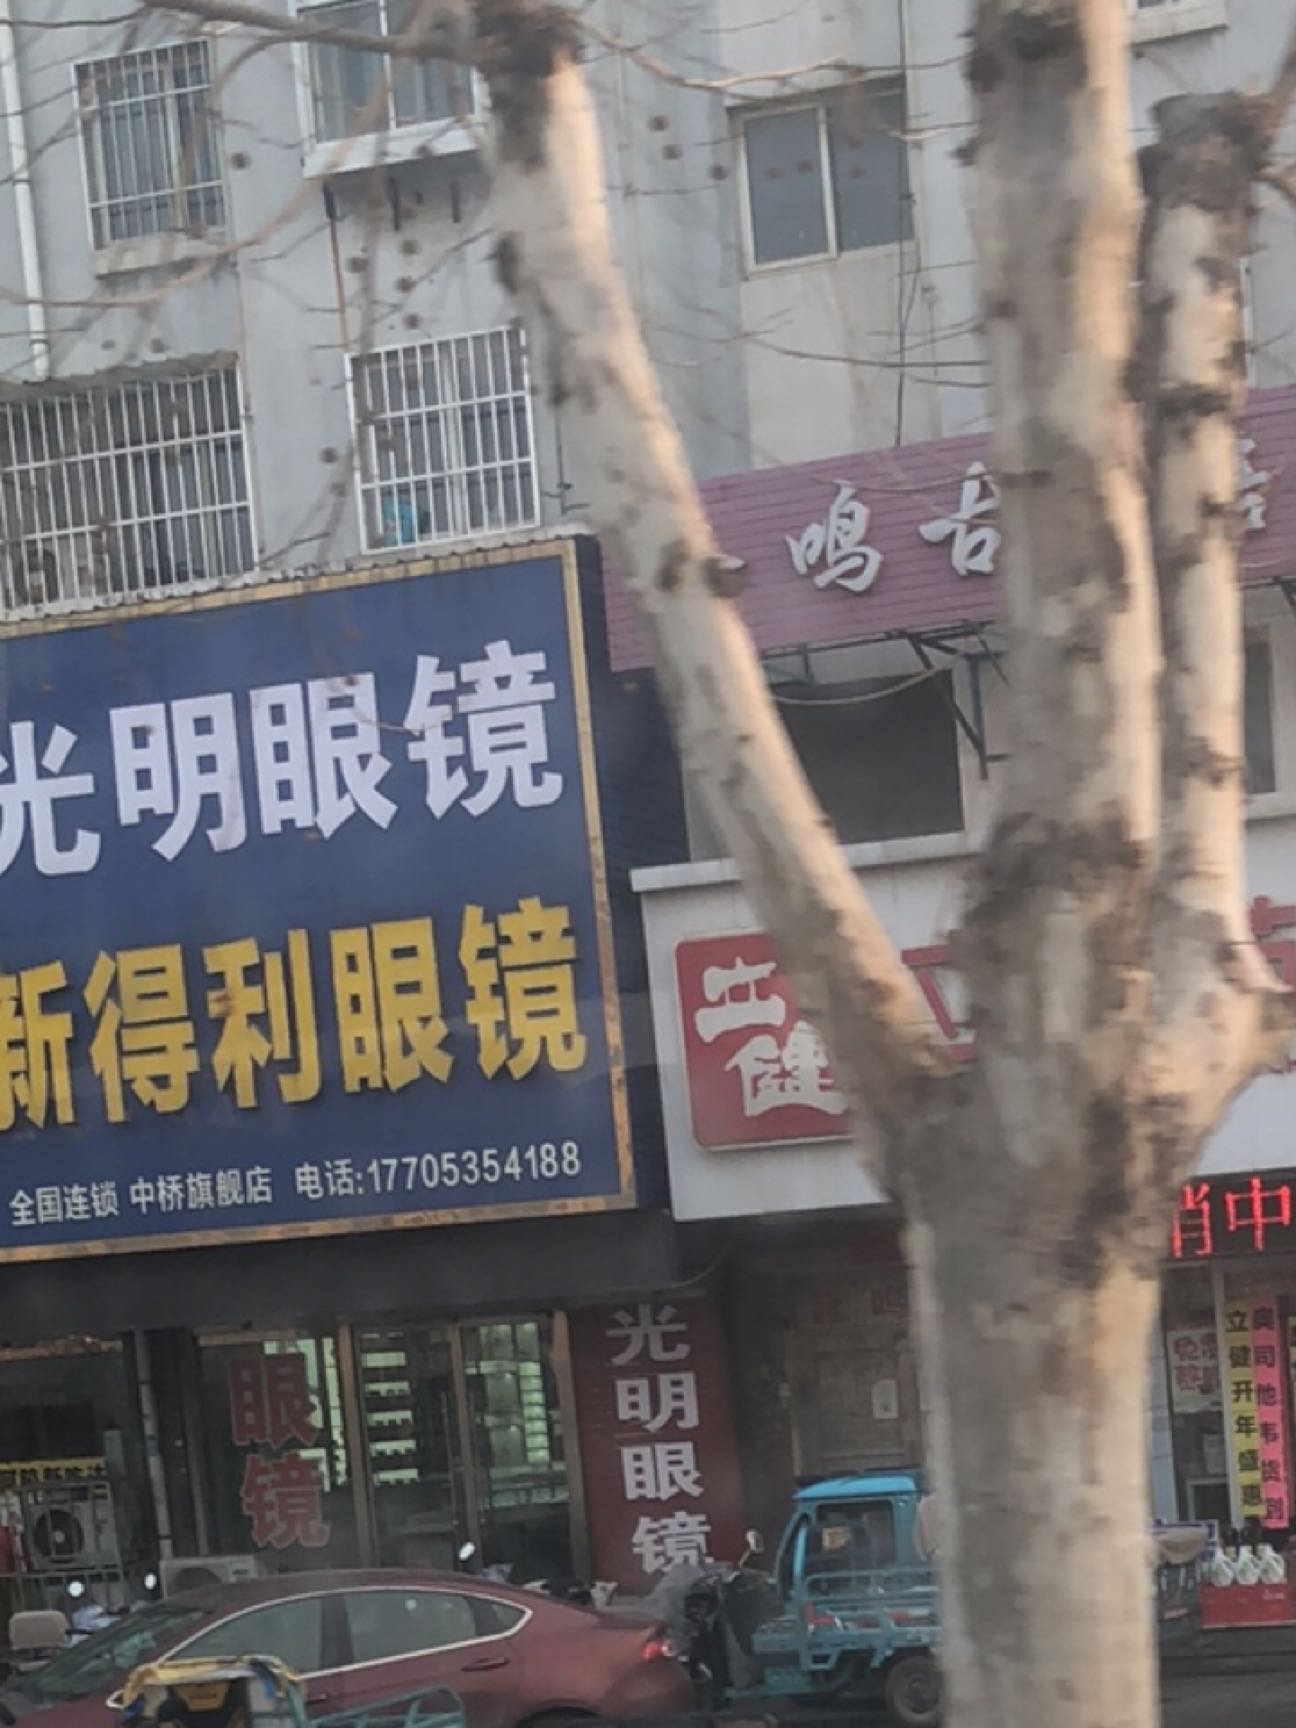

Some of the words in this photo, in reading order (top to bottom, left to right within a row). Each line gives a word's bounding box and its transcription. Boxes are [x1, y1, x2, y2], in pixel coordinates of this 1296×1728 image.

[0, 640, 563, 876] 光明眼镜
[0, 896, 588, 1133] 新得利眼镜
[11, 1182, 118, 1226] 全国连锁
[130, 1166, 273, 1211] 中桥旗舰店
[295, 1141, 581, 1199] 电话:17705354188
[228, 1352, 332, 1550] 眼镜
[605, 1303, 714, 1576] 光明眼镜
